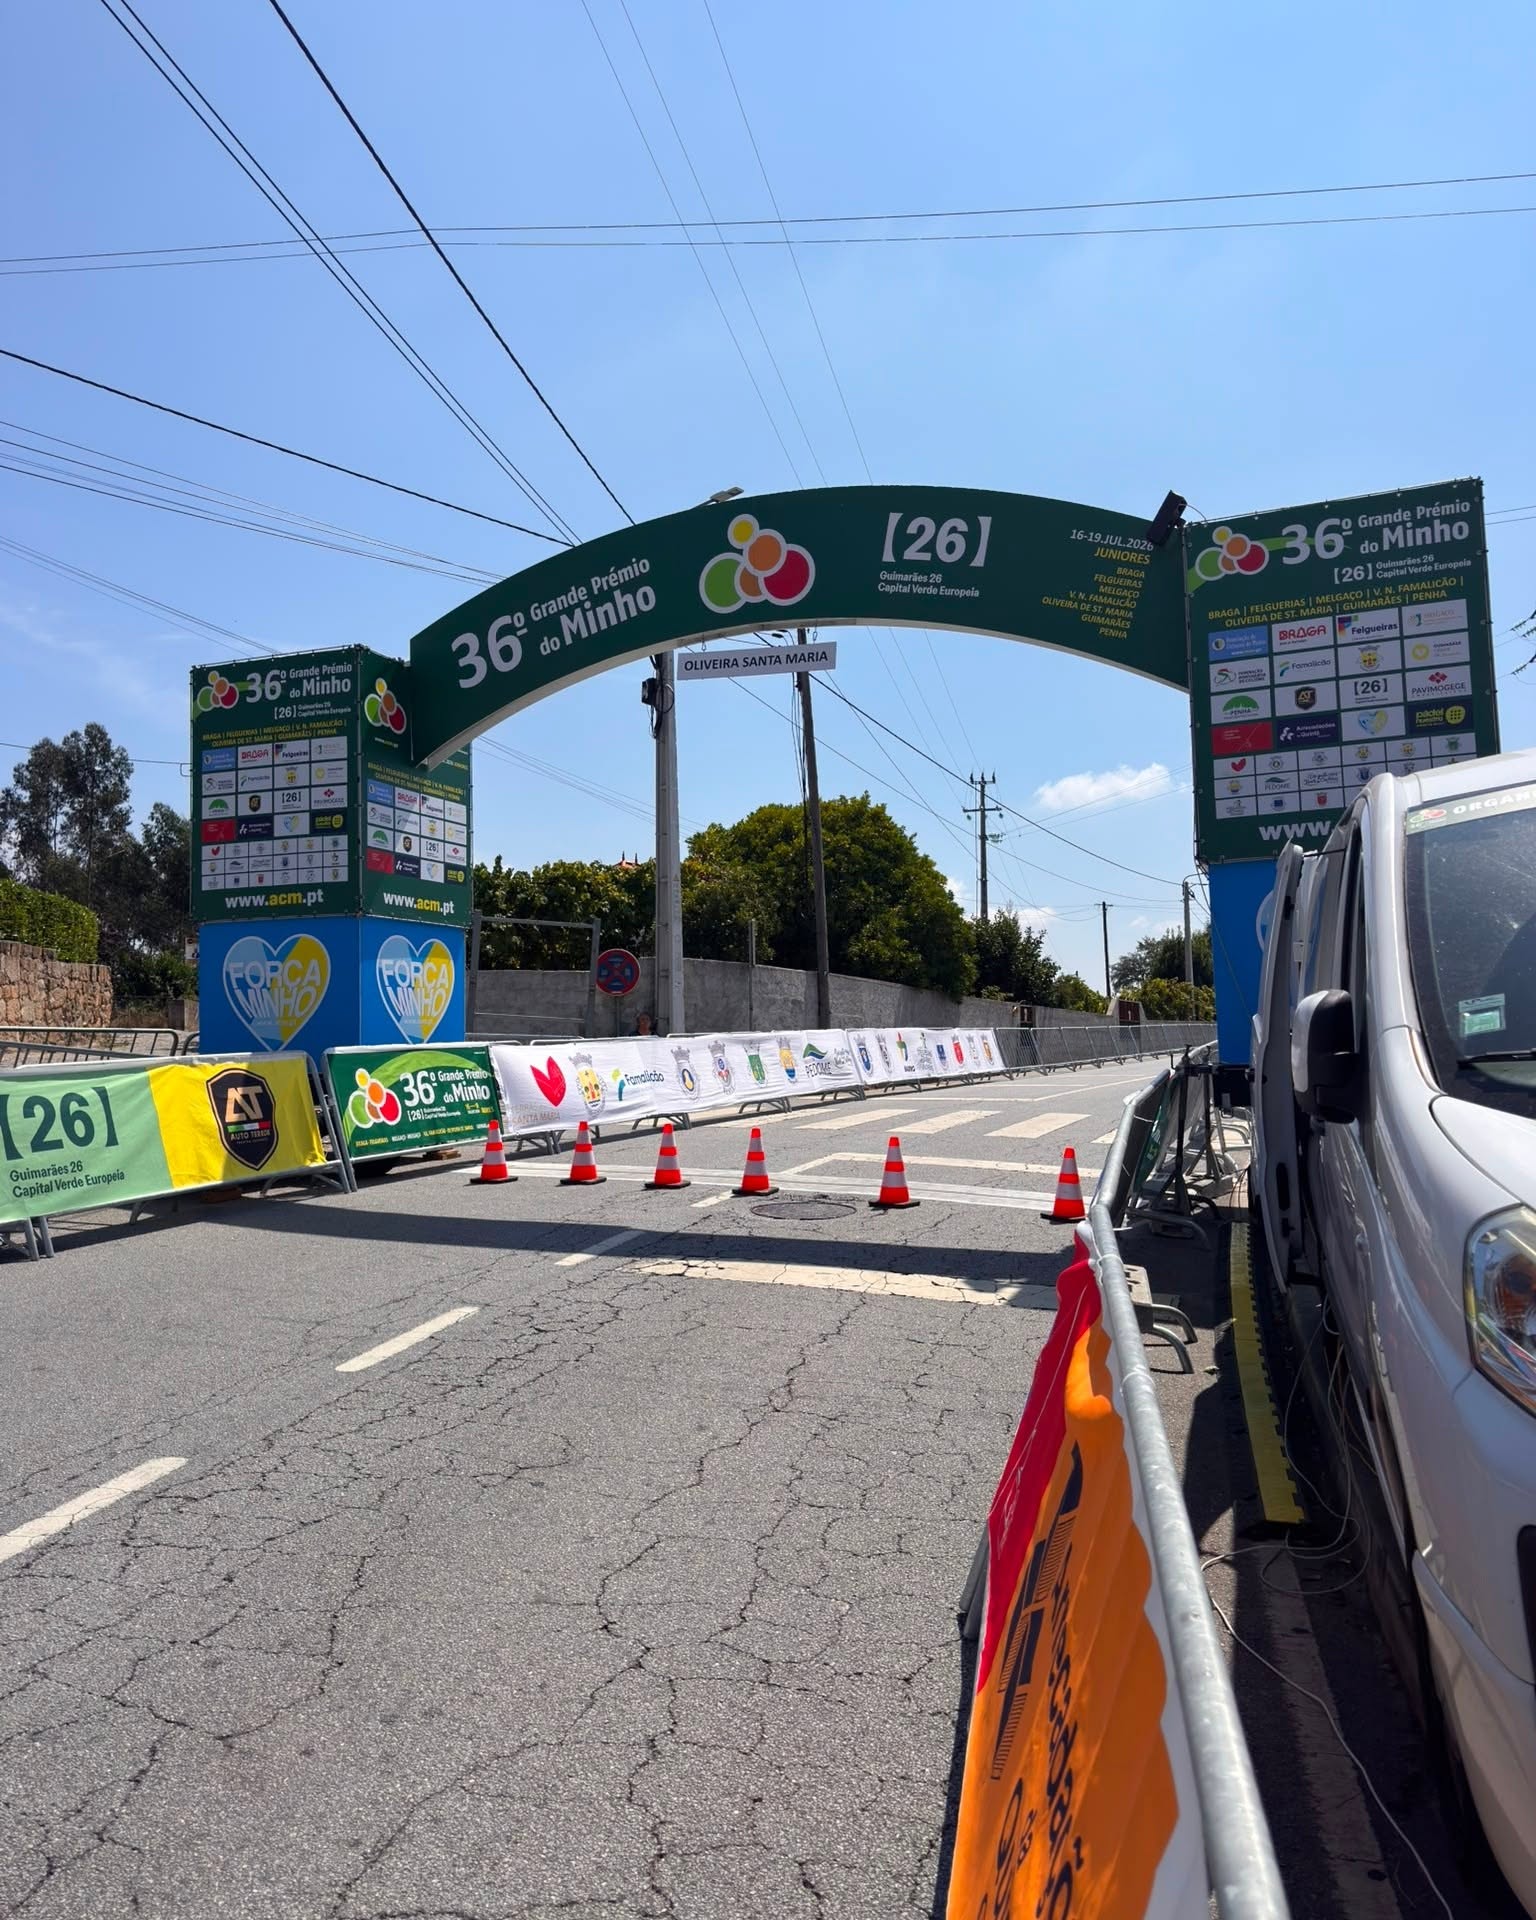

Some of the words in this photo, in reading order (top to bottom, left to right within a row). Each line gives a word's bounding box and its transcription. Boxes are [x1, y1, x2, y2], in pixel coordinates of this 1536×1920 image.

[1070, 529, 1154, 551] 16-19.JUL.2026
[1281, 518, 1352, 565] 36º
[1358, 508, 1411, 528] Grande
[1416, 500, 1470, 517] Prémio
[1360, 540, 1379, 554] do
[1382, 519, 1469, 550] Minho
[1094, 547, 1150, 565] JUNIORES
[1376, 557, 1421, 569] Guimarães
[1422, 554, 1434, 563] 26
[879, 571, 928, 584] Guimarães
[929, 574, 942, 584] 26
[1116, 567, 1145, 578] BRAGA
[1376, 566, 1407, 579] Capital
[1408, 564, 1433, 575] Verde
[1434, 558, 1471, 572] Europeia
[878, 582, 911, 595] Capital
[912, 585, 938, 596] Verde
[938, 586, 980, 598] Europeia
[1094, 574, 1143, 588] FELGUEIRAS
[1099, 585, 1140, 600] MELGAÇO
[1208, 607, 1240, 620] BRAGA
[1316, 591, 1363, 605] MELGAÇO
[1373, 587, 1382, 596] V.
[1385, 585, 1396, 595] N.
[1398, 576, 1457, 593] FAMALICÃO
[1042, 596, 1079, 609] OLIVEIRA
[1080, 602, 1090, 612] DE
[1092, 604, 1103, 613] ST.
[1104, 608, 1133, 619] MARIA
[1225, 614, 1268, 628] OLIVEIRA
[1270, 612, 1283, 622] DE
[1284, 610, 1299, 620] ST.
[1300, 605, 1333, 617] MARIA
[1343, 596, 1402, 611] GUIMARÃES
[1412, 590, 1447, 602] PENHA
[451, 612, 528, 689] 36º
[530, 586, 588, 622] Grande
[591, 558, 650, 595] Prémio
[539, 636, 561, 655] do
[560, 585, 656, 646] Minho
[1081, 613, 1131, 629] GUIMARÃES
[1351, 623, 1398, 635] Felgueiras
[1099, 628, 1127, 639] PENHA
[1279, 625, 1326, 641] BRAGA
[684, 658, 739, 671] OLIVEIRA
[742, 655, 782, 668] SANTA
[785, 651, 828, 665] MARIA
[246, 670, 287, 703] 36º
[289, 667, 319, 679] Grande
[322, 662, 352, 675] Prémio
[289, 688, 300, 698] do
[302, 676, 351, 697] Minho
[1411, 682, 1466, 695] PAVIMOGEGE
[225, 889, 324, 908] www.acm.pt
[383, 892, 455, 914] www.acm.pt
[227, 959, 321, 991] FORÇA
[380, 959, 449, 991] FORÇA
[234, 987, 318, 1018] MINHO
[386, 987, 446, 1018] MINHO
[624, 1069, 665, 1085] Famalicão
[400, 1070, 438, 1107] 36º
[438, 1070, 464, 1082] Grande
[443, 1092, 454, 1103] do
[451, 1081, 491, 1102] Minho
[230, 1132, 249, 1141] AUTO
[9, 1164, 69, 1182] Guimarães
[69, 1160, 83, 1174] 26
[12, 1177, 54, 1198] Capital
[54, 1176, 85, 1193] Verde
[85, 1170, 125, 1190] Europeia
